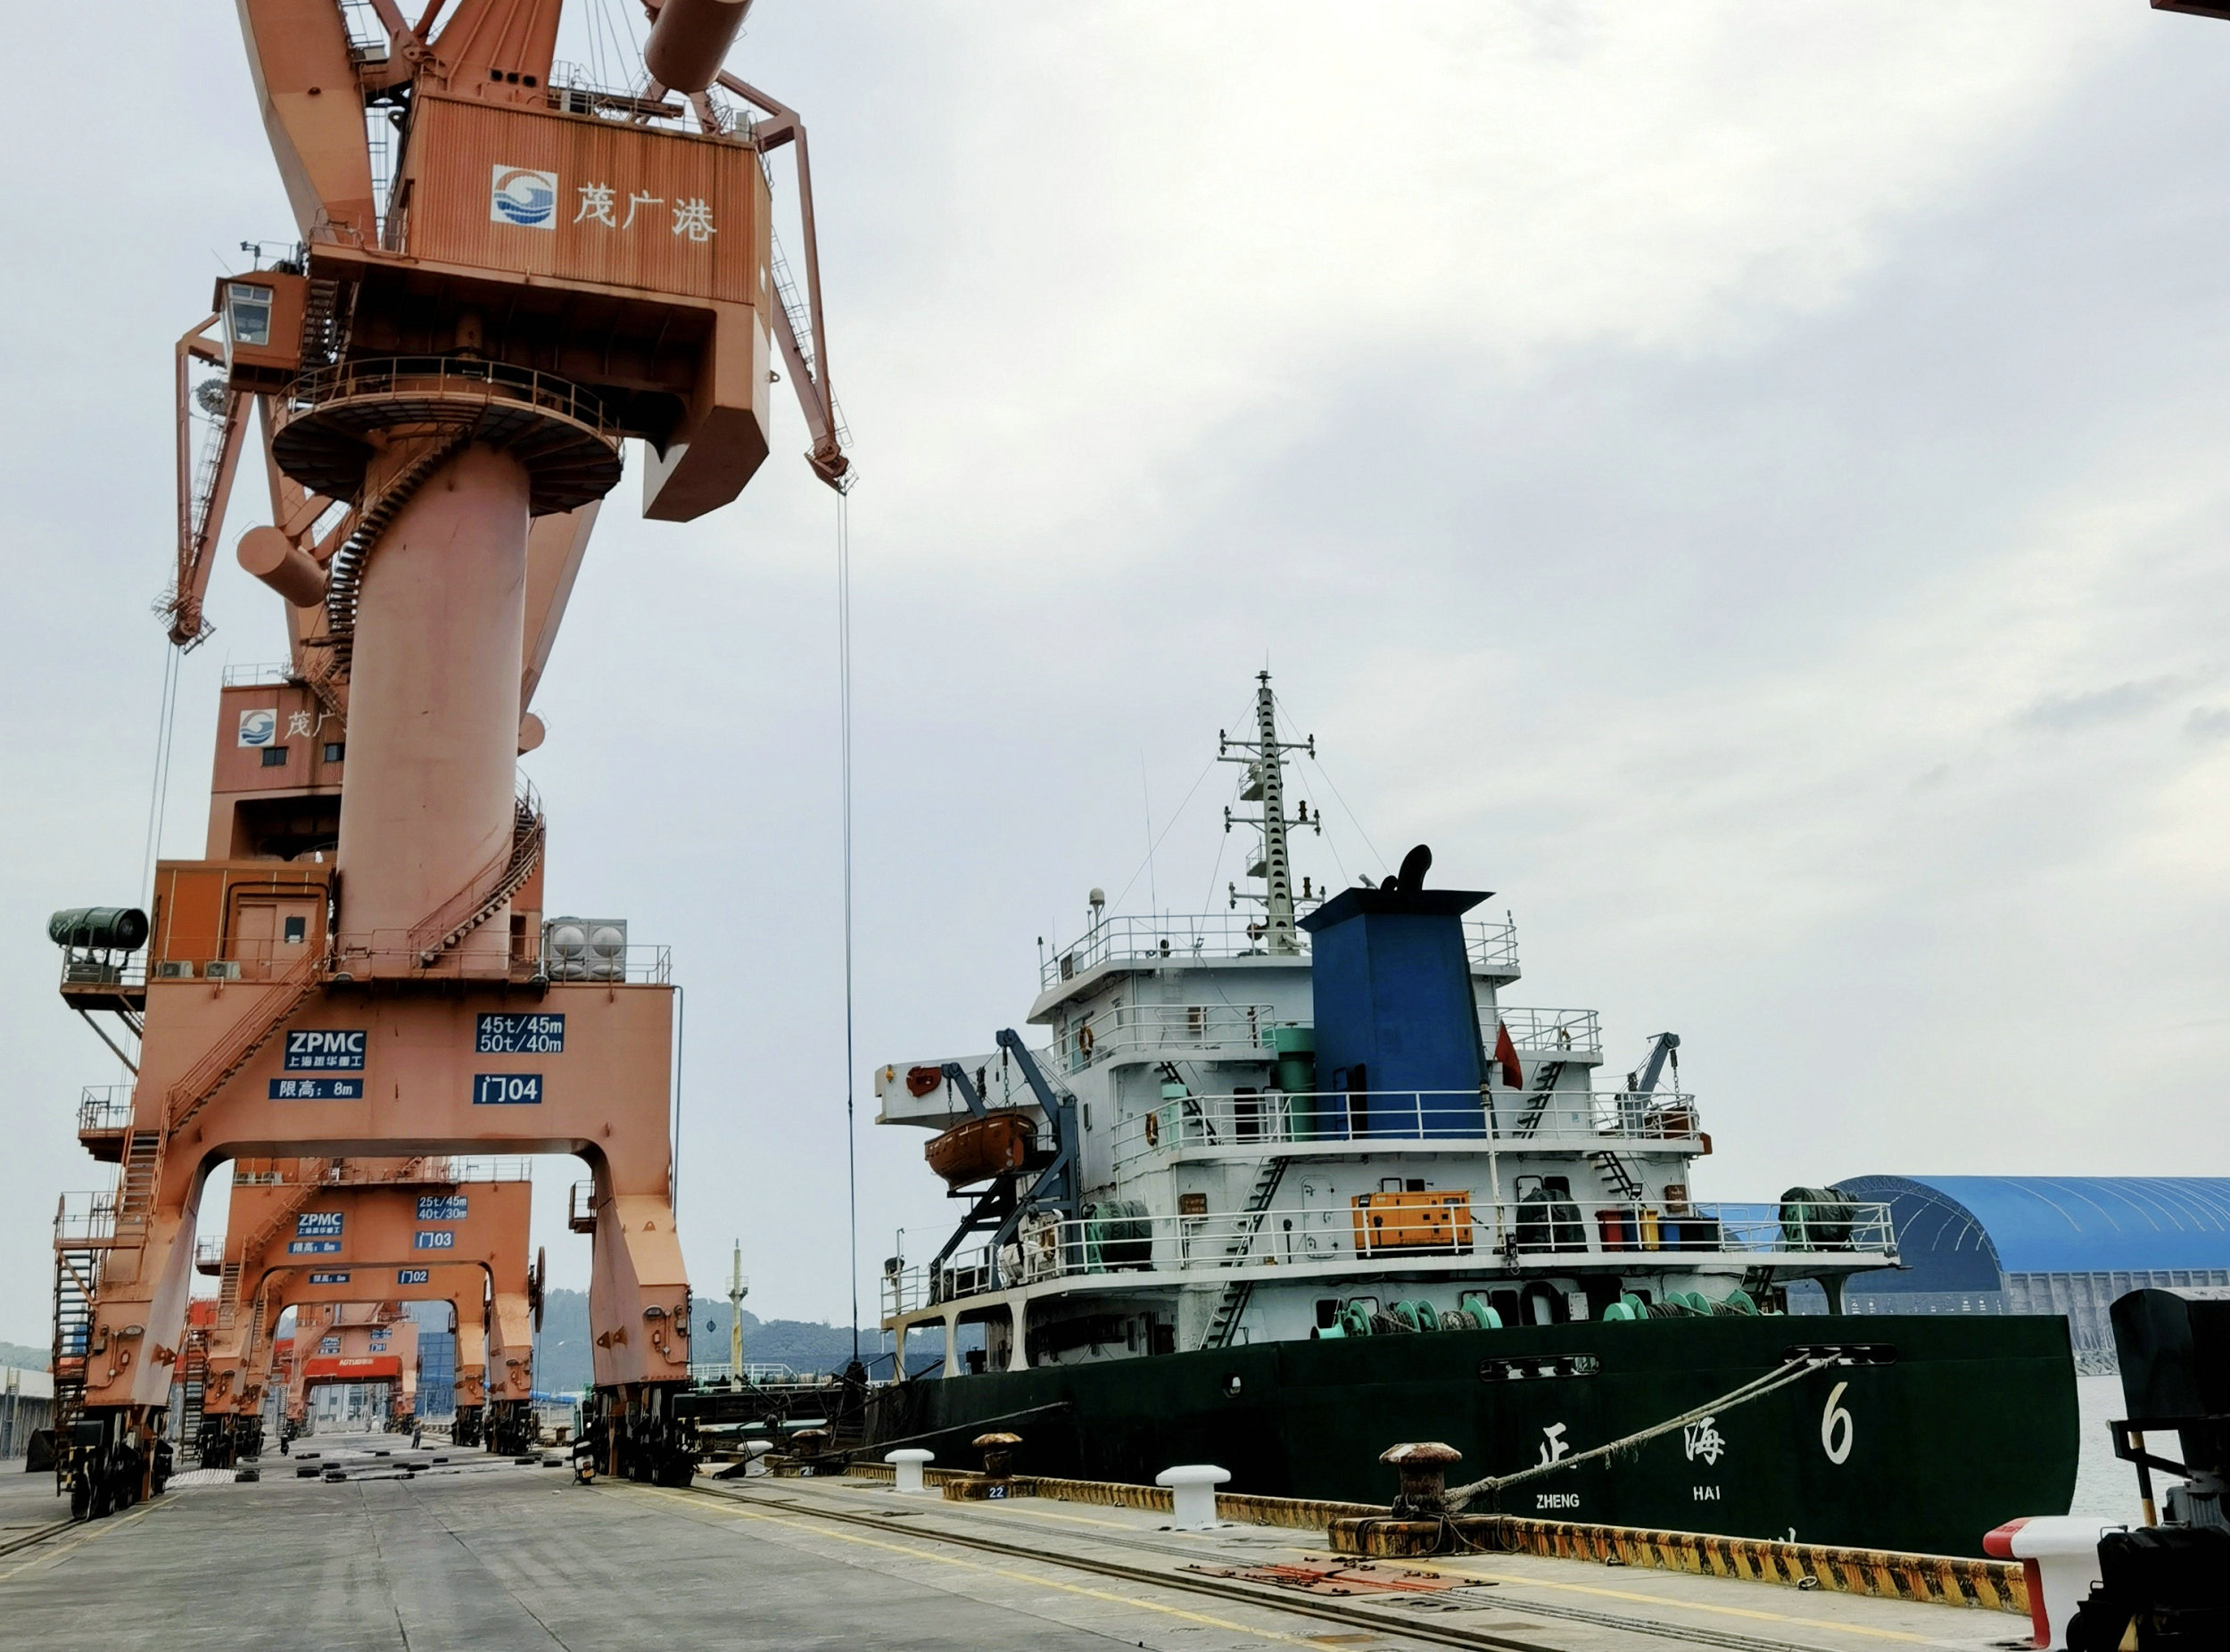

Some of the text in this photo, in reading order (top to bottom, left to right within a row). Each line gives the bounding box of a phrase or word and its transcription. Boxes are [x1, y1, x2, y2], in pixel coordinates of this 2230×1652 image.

[573, 180, 717, 242] 茂广港
[284, 708, 347, 741] 茂广
[480, 1015, 562, 1034] 45t/45m
[289, 1032, 364, 1053] ZPMC
[480, 1034, 562, 1053] 50t/40m
[481, 1075, 539, 1103] 门04
[419, 1195, 467, 1207] 25t/45m
[299, 1212, 342, 1227] ZPMC
[418, 1208, 467, 1219] 40t/30m
[419, 1231, 451, 1248] 门03
[1821, 1381, 1854, 1465] 6
[988, 1487, 1004, 1499] 22
[1536, 1485, 1721, 1510] ZHENG HAI
